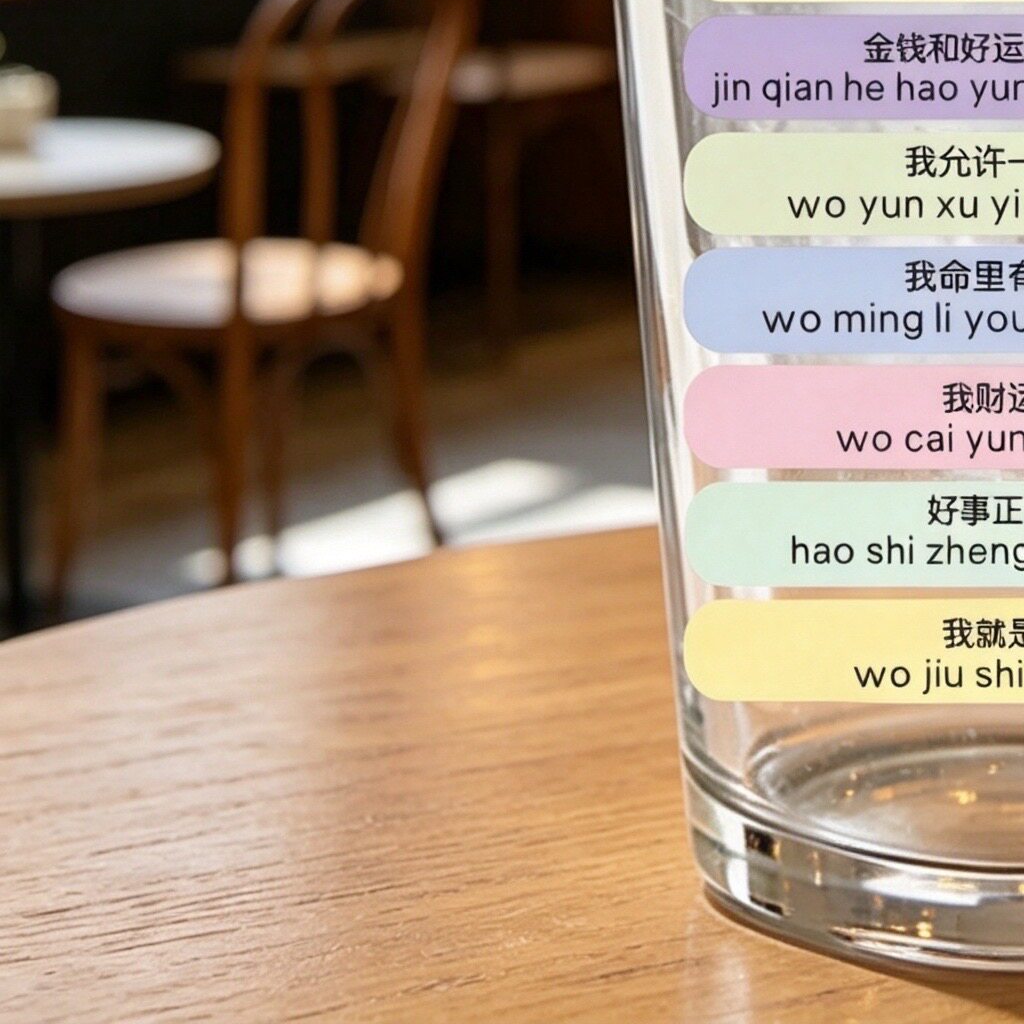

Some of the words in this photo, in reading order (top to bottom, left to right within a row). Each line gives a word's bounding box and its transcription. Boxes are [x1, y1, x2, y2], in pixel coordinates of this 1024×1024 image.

[710, 71, 751, 109] jin
[761, 71, 834, 109] qian
[843, 70, 885, 102] he
[896, 70, 959, 102] hao
[787, 195, 846, 219] wo
[859, 195, 924, 226] yun
[936, 196, 978, 219] xu
[990, 188, 1020, 226] yi
[761, 309, 822, 334] wo
[834, 302, 924, 341] ming
[935, 301, 951, 333] li
[836, 430, 893, 453] wo
[904, 422, 953, 453] cai
[791, 534, 855, 565] hao
[866, 534, 914, 565] shi
[853, 666, 911, 689] wo
[922, 658, 963, 695] jiu
[975, 658, 1023, 688] shi
